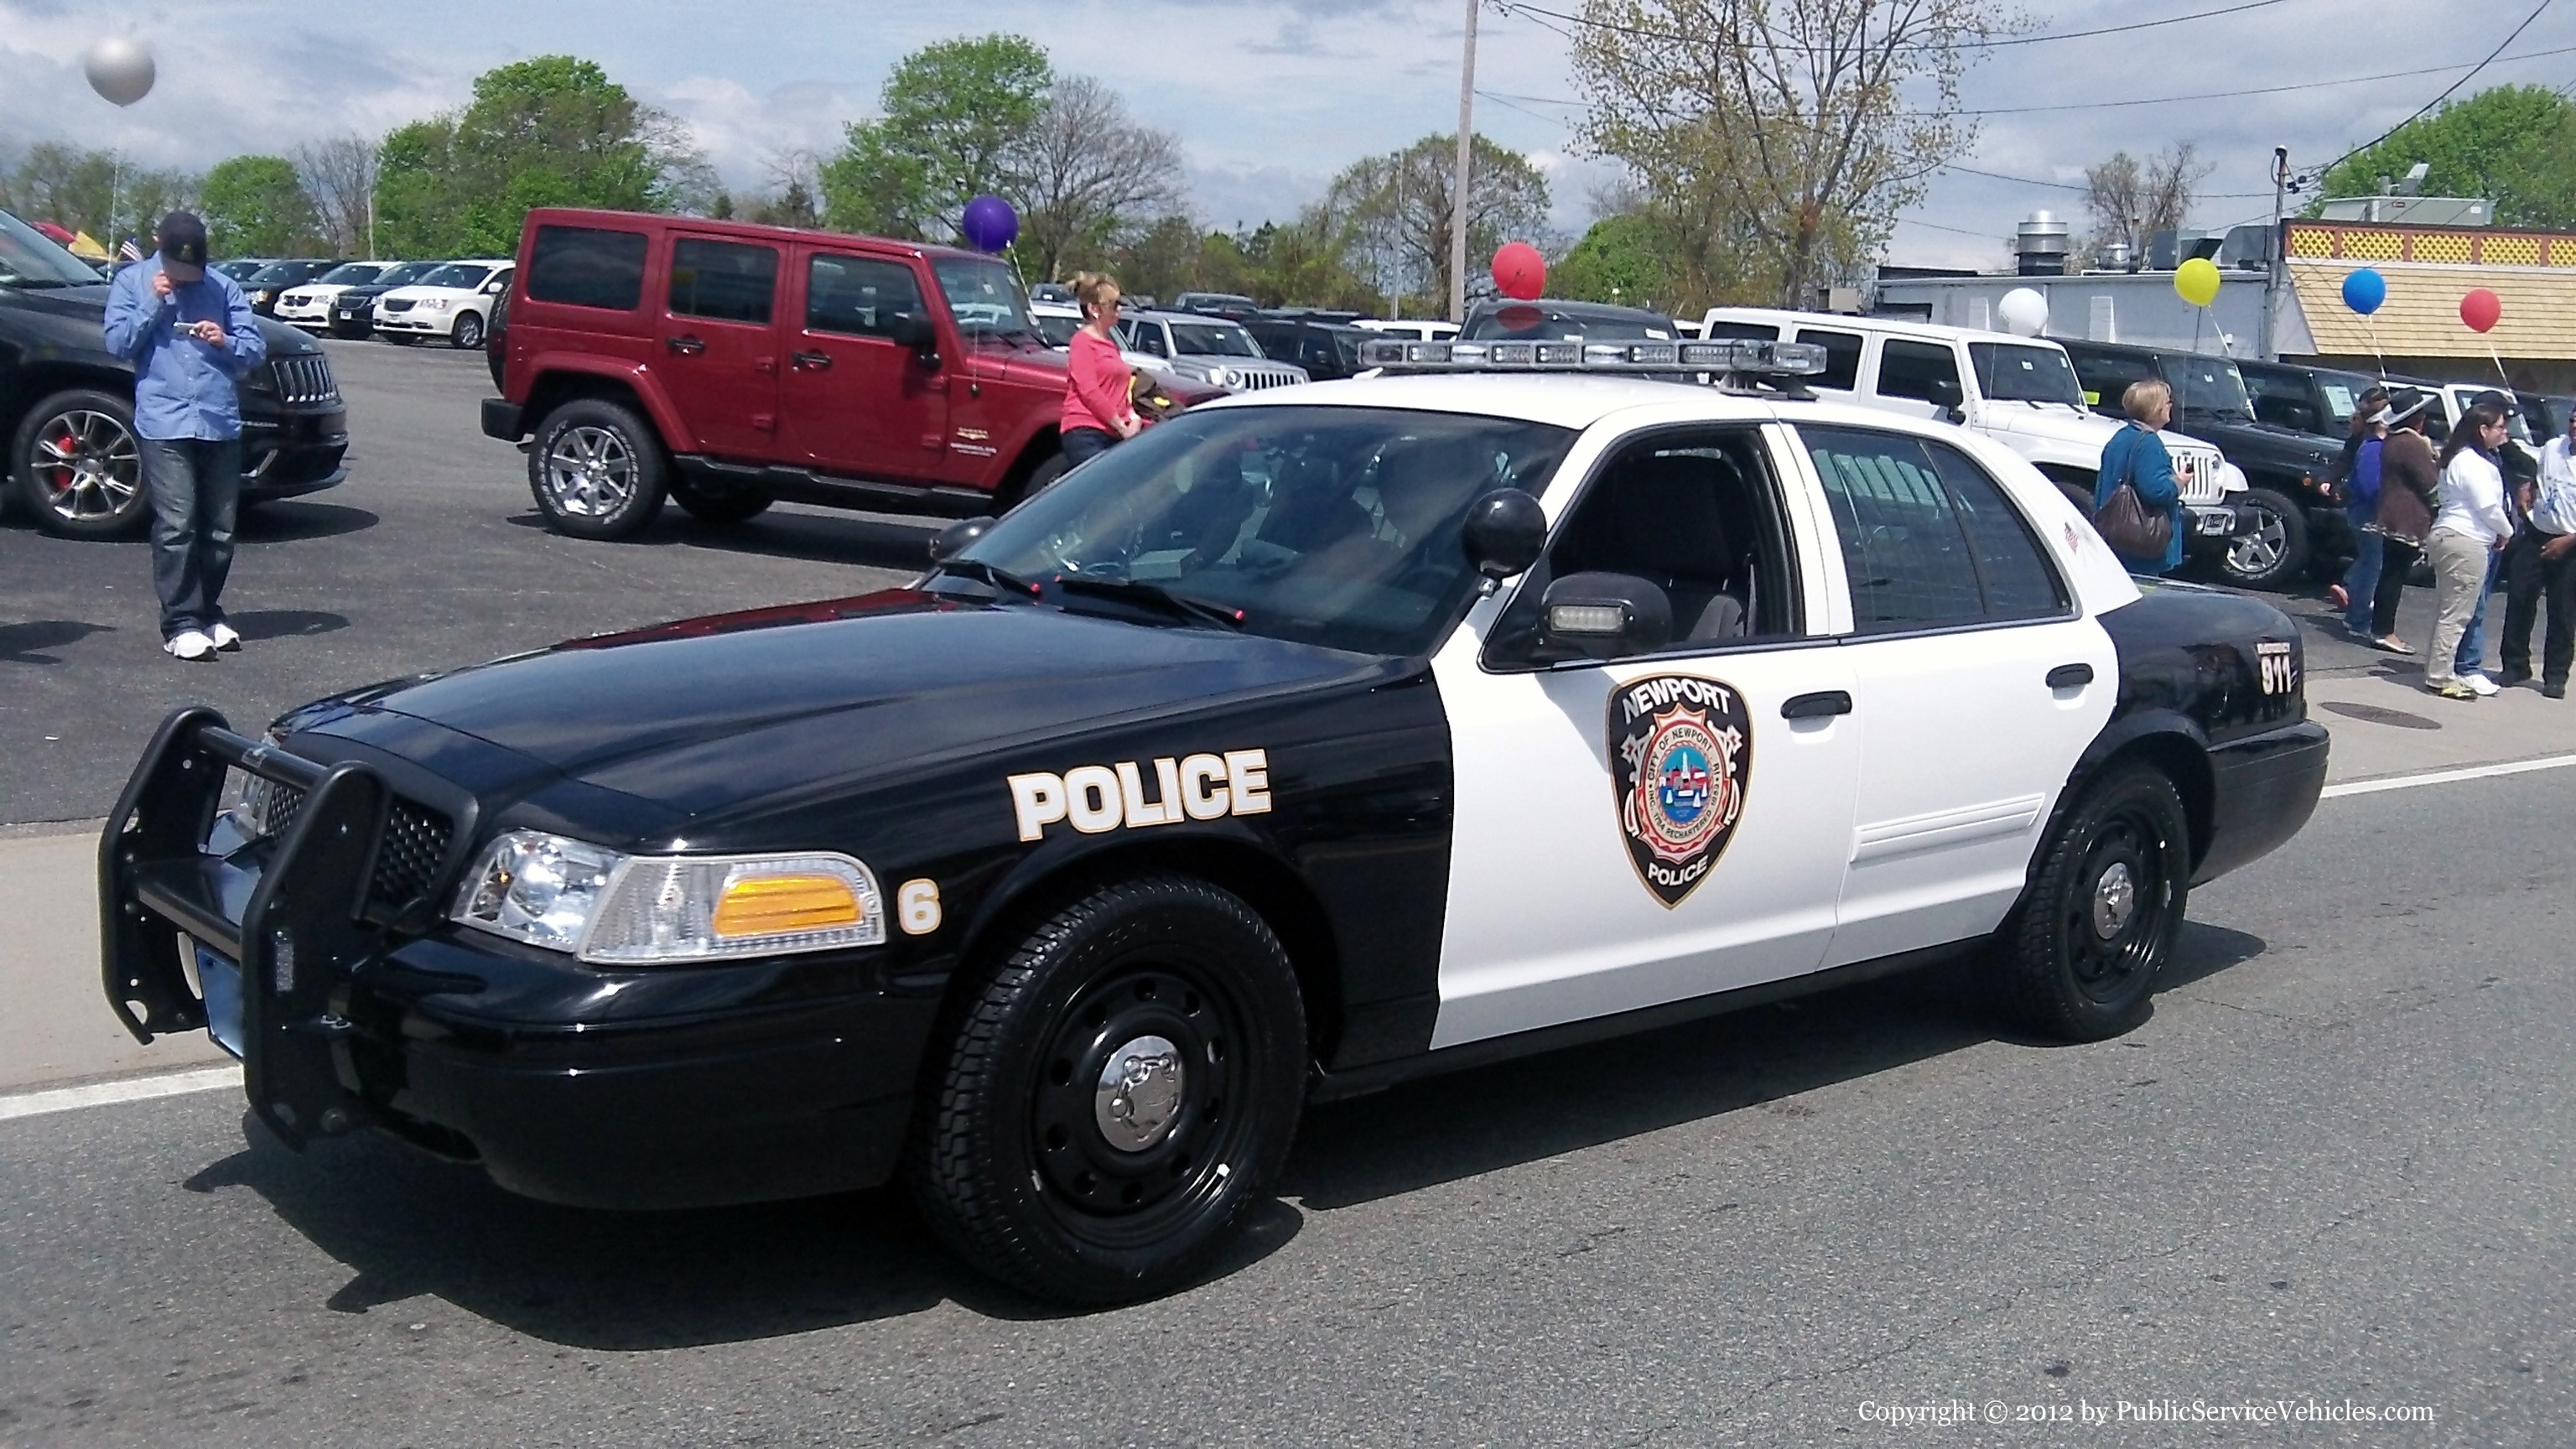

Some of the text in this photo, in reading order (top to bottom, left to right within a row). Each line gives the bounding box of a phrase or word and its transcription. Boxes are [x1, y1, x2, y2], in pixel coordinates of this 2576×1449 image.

[2261, 655, 2292, 695] 911
[1623, 678, 1731, 724] NEWPORT
[1648, 751, 1659, 781] CITY
[1659, 735, 1670, 750] OF
[1007, 748, 1272, 842] POLICE
[1648, 854, 1709, 886] POLICE
[897, 878, 943, 935] 6
